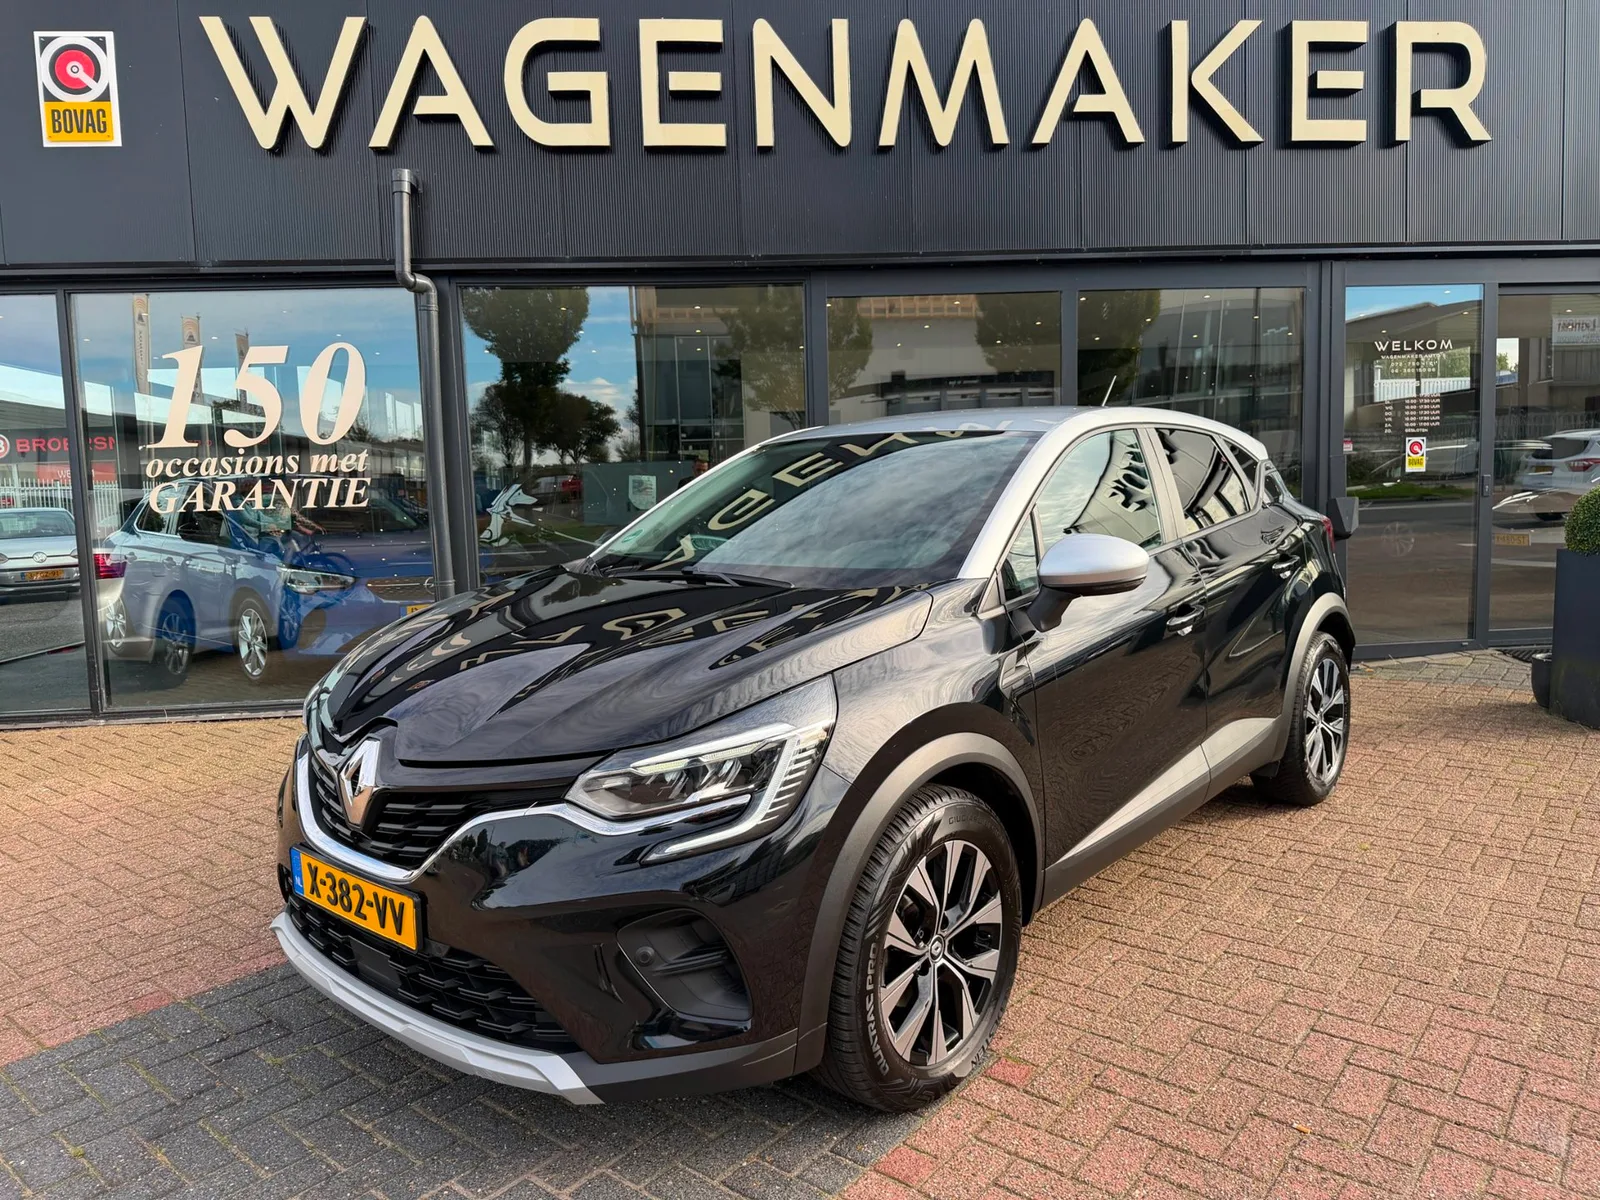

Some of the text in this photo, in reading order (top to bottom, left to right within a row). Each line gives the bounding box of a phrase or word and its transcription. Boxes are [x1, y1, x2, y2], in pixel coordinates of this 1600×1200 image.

[199, 15, 1491, 150] WAGENMAKER
[51, 107, 107, 135] BOVAG
[1374, 339, 1453, 351] WELKOM
[146, 342, 367, 448] 150
[146, 447, 369, 477] occasions met
[1407, 457, 1424, 467] BOVAG
[149, 477, 371, 513] GARANTIE
[307, 862, 405, 936] X-382-VV
[865, 942, 889, 1076] QUATRAC PRO
